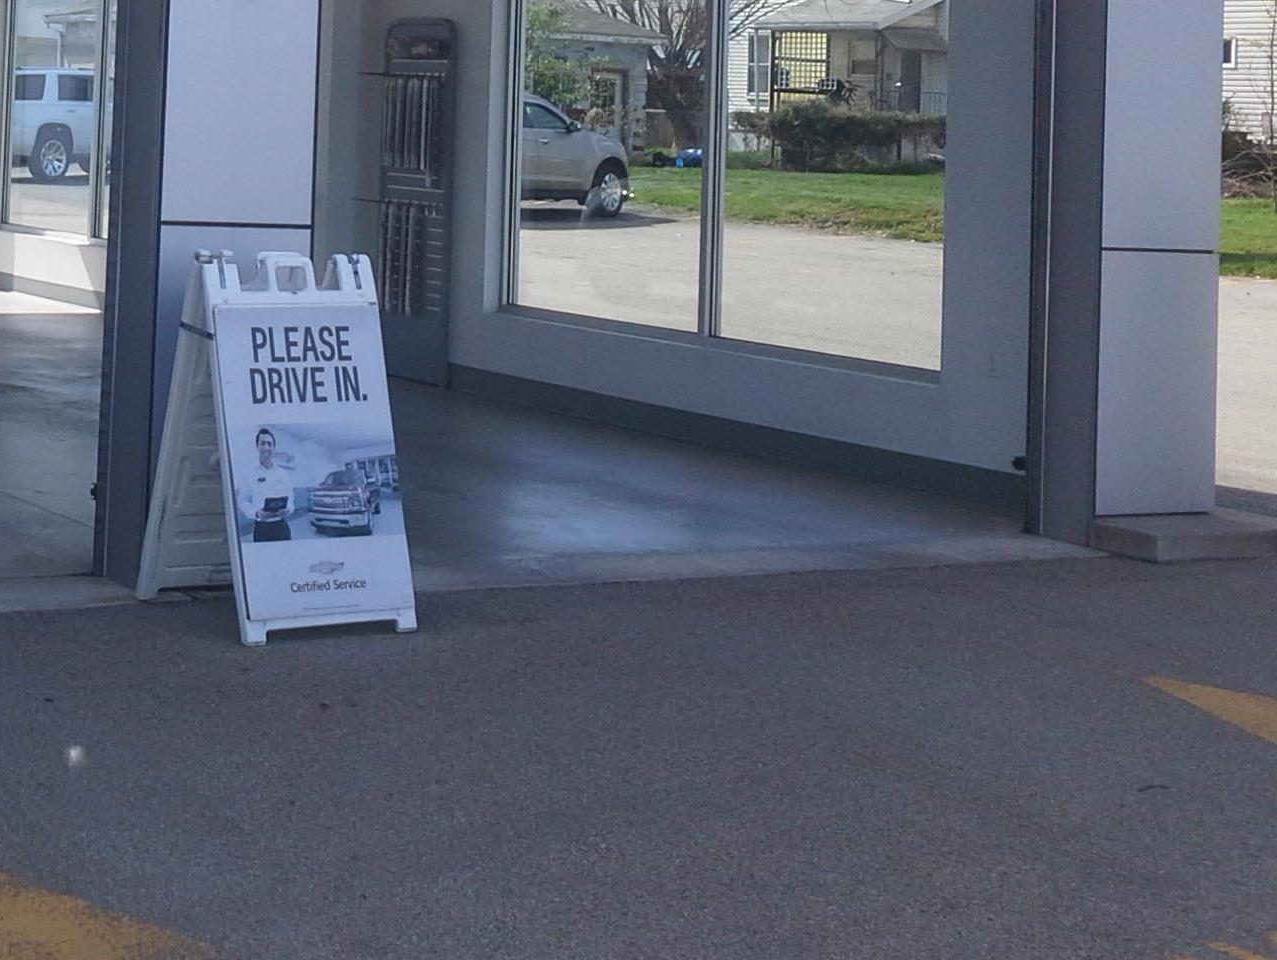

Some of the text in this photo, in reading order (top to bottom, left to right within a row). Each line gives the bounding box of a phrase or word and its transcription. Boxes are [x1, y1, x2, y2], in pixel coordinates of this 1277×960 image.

[251, 326, 352, 363] PLEASE
[249, 366, 368, 404] DRIVE IN.
[290, 579, 367, 593] Certified Service
